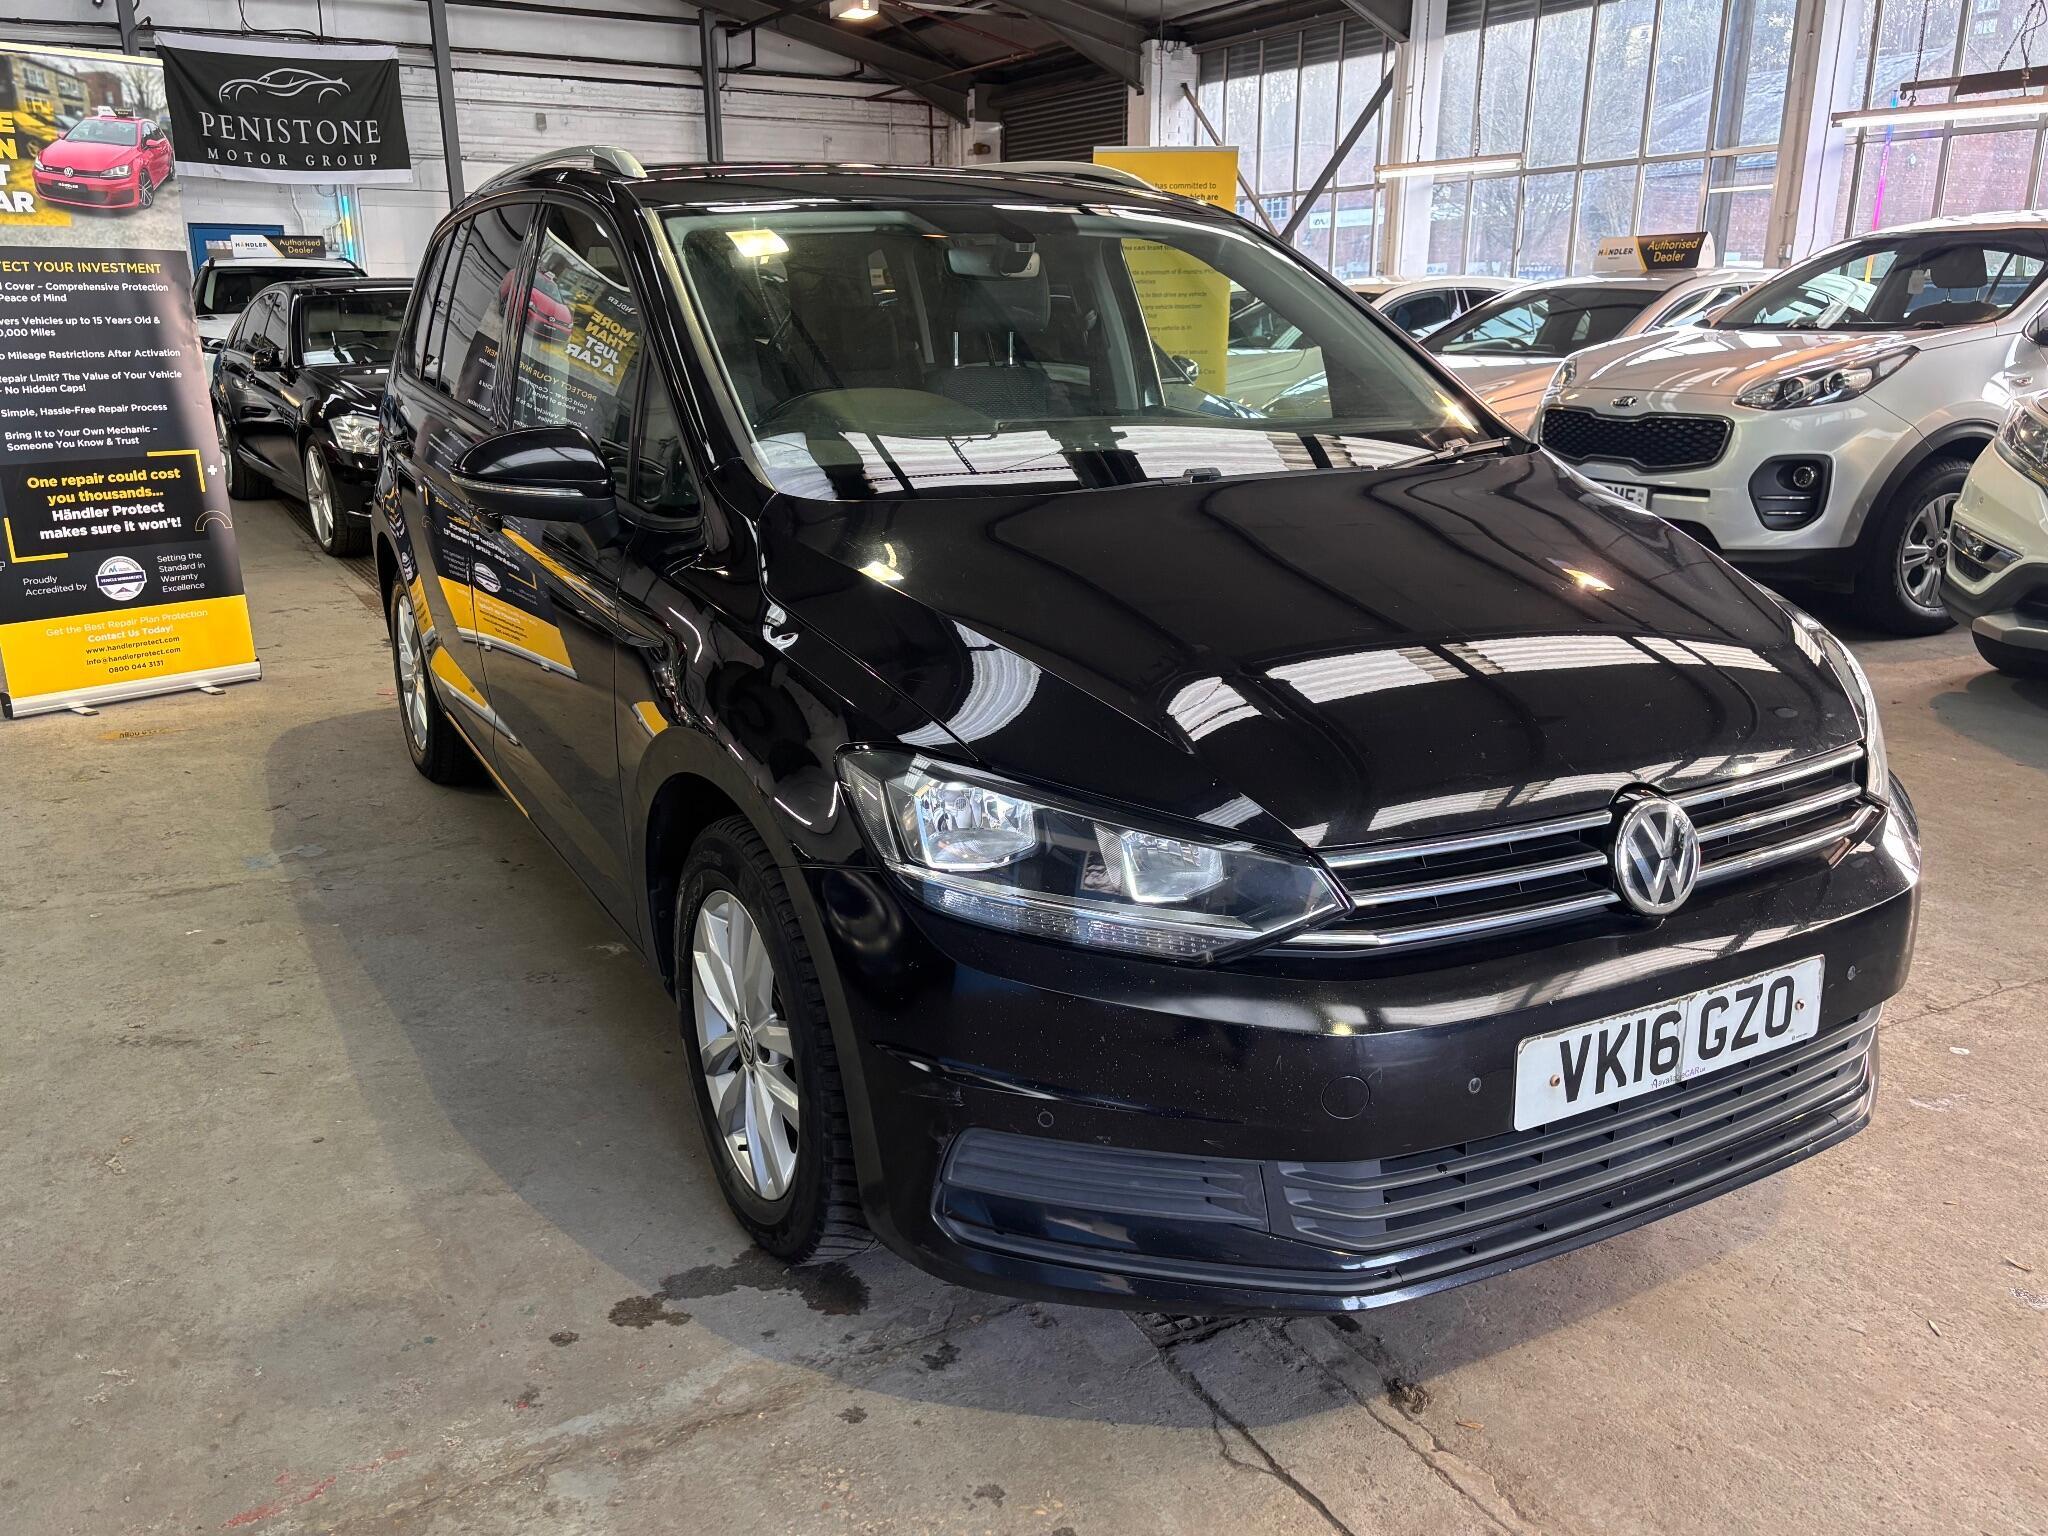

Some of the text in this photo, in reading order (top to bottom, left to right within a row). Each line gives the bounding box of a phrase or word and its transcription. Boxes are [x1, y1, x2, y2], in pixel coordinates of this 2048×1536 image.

[0, 112, 16, 133] E
[199, 111, 381, 145] PENISTONE
[0, 138, 18, 160] N
[207, 148, 378, 166] MOTOR GROUP
[0, 190, 37, 212] AR
[280, 239, 321, 247] Authorised
[288, 246, 314, 254] Dealer
[1647, 238, 1700, 250] Authorised
[1653, 251, 1685, 262] Dealer
[33, 261, 74, 272] YOUR
[77, 262, 161, 274] INVESTMENT
[5, 282, 35, 291] Cover
[45, 282, 120, 292] Comprehensive
[122, 283, 169, 291] Protection
[31, 294, 41, 302] of
[43, 294, 67, 302] Mind
[22, 316, 63, 325] Vehicles
[66, 318, 77, 326] up
[80, 316, 91, 324] to
[92, 316, 103, 324] 15
[105, 316, 132, 324] Years
[134, 316, 151, 324] Old
[153, 316, 161, 324] &
[30, 328, 56, 336] Miles
[7, 351, 47, 361] Mileage
[48, 350, 105, 359] Restrictions
[107, 349, 132, 357] After
[134, 348, 181, 357] Activation
[29, 373, 60, 382] Limit?
[62, 372, 80, 381] The
[82, 371, 109, 380] Value
[111, 371, 121, 380] of
[123, 371, 147, 379] Your
[148, 370, 182, 379] Vehicle
[5, 383, 87, 394] No Hidden Caps!
[0, 403, 168, 418] Simple, Hassle-Free Repair Process
[5, 431, 33, 440] Bring
[44, 430, 55, 438] to
[57, 428, 81, 437] Your
[83, 427, 105, 436] Own
[106, 425, 151, 435] Mechanic
[7, 436, 140, 451] Someone You Know & Trust
[27, 467, 181, 488] One repair could cost
[47, 492, 76, 507] you
[52, 501, 165, 522] Händler Protect
[39, 525, 88, 540] makes
[91, 523, 122, 536] sure
[124, 519, 136, 533] it
[157, 552, 202, 564] Setting the
[158, 561, 206, 573] Standard in
[22, 575, 58, 586] Proudly
[160, 573, 199, 583] Warranty
[25, 582, 88, 596] Accredited by
[162, 582, 206, 593] Excellence
[46, 608, 209, 637] Get the Best Repair Plan Protection
[87, 631, 126, 643] Contact
[127, 629, 140, 637] Us
[85, 635, 180, 655] www.handlerprotect.com
[108, 659, 165, 674] 0800 044 3131
[1559, 975, 1796, 1104] VK16 GZO
